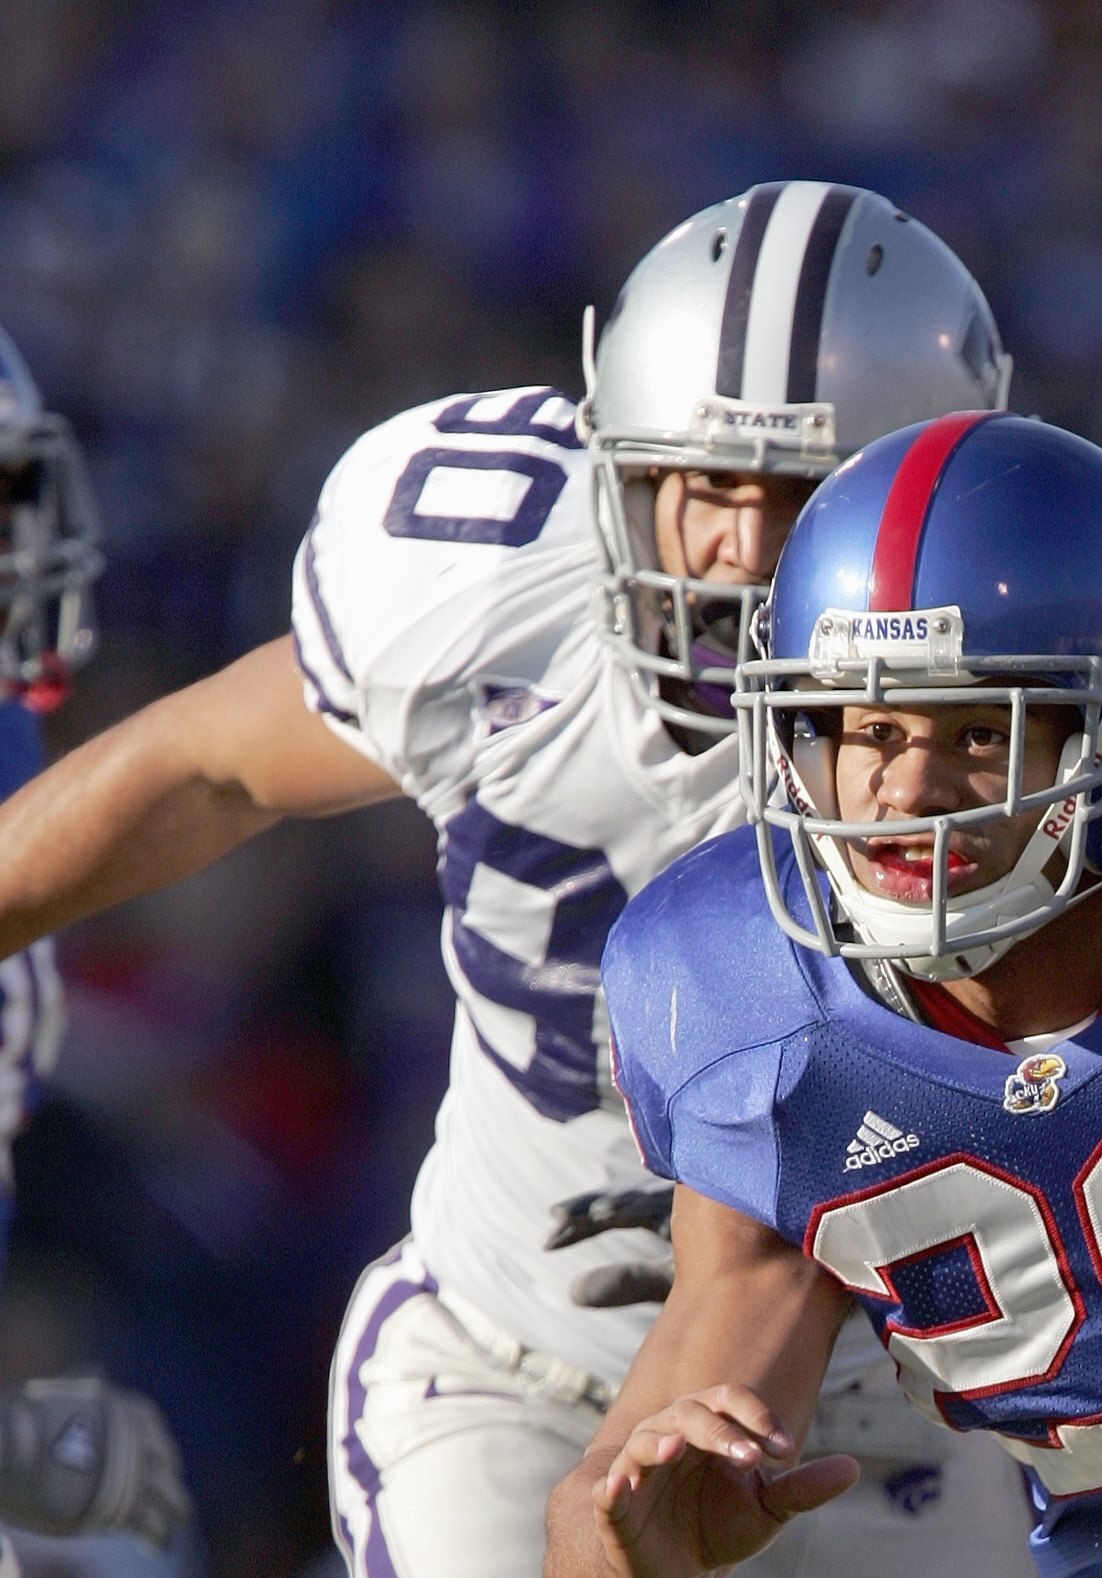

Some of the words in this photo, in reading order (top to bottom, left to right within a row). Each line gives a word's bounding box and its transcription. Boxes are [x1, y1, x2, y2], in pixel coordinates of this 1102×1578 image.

[725, 410, 798, 429] STATE
[851, 617, 928, 641] KANSAS
[844, 1133, 920, 1172] adidas
